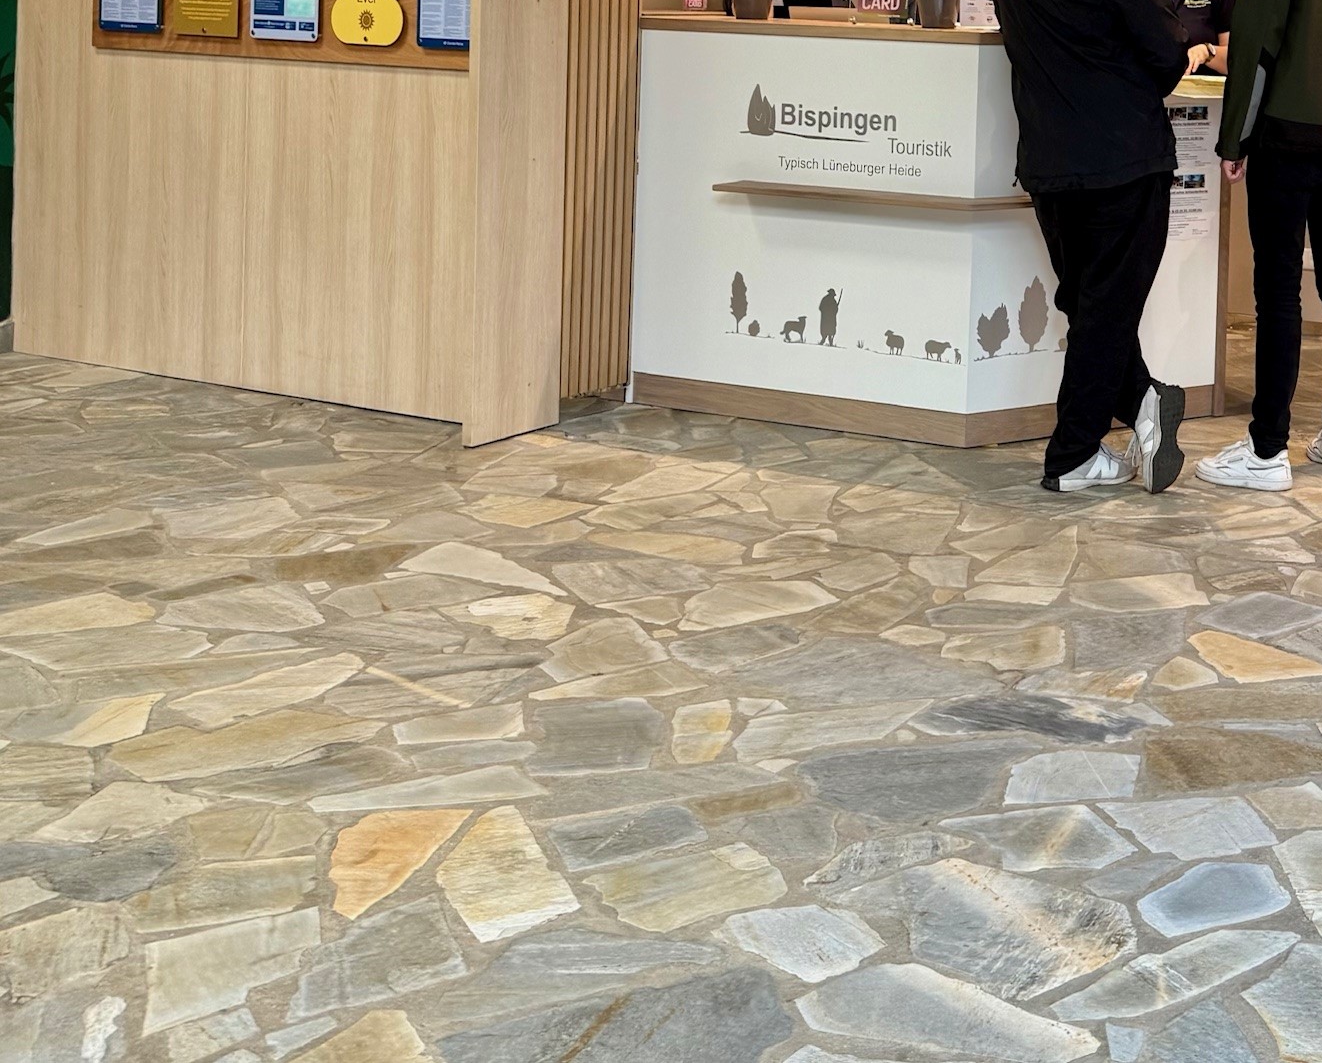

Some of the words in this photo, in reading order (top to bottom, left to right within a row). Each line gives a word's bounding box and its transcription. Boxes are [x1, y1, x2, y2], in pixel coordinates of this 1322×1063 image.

[780, 102, 898, 136] Bispingen
[888, 138, 952, 158] Touristik
[778, 156, 819, 172] Typisch
[822, 158, 886, 176] Lüneburger
[888, 163, 922, 178] Heide
